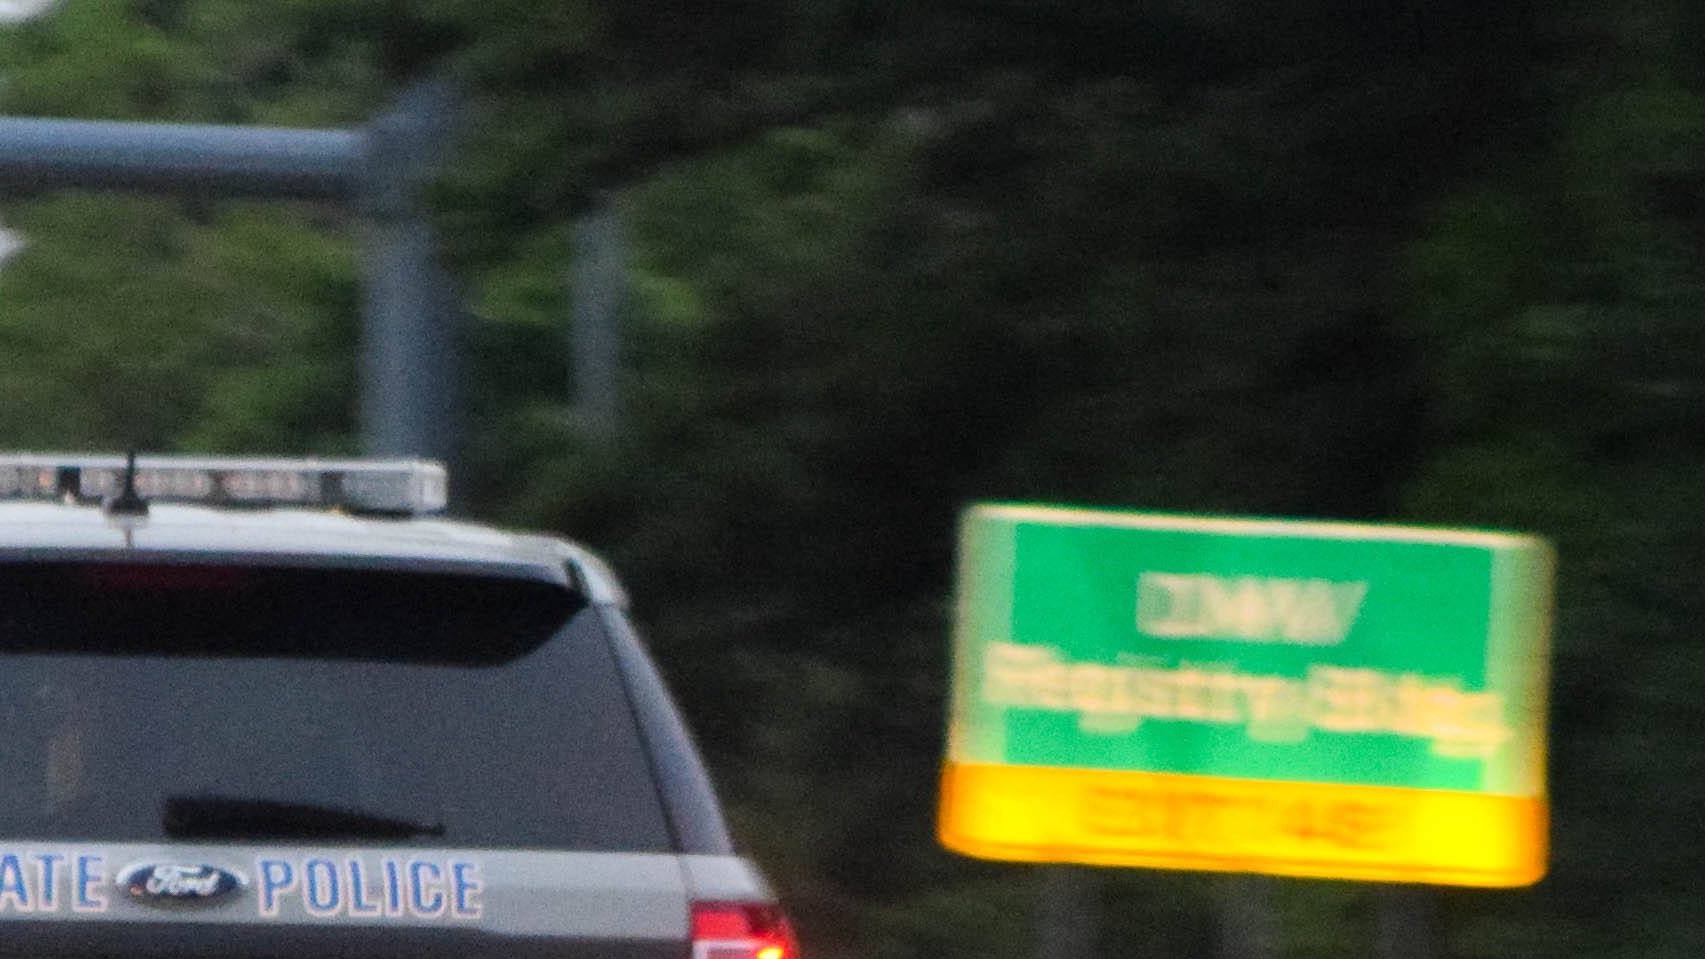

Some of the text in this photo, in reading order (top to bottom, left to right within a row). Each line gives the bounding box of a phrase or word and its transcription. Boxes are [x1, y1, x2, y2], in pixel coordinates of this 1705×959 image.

[983, 640, 1310, 744] Registry
[144, 864, 220, 897] Ford
[256, 856, 484, 919] POLICE
